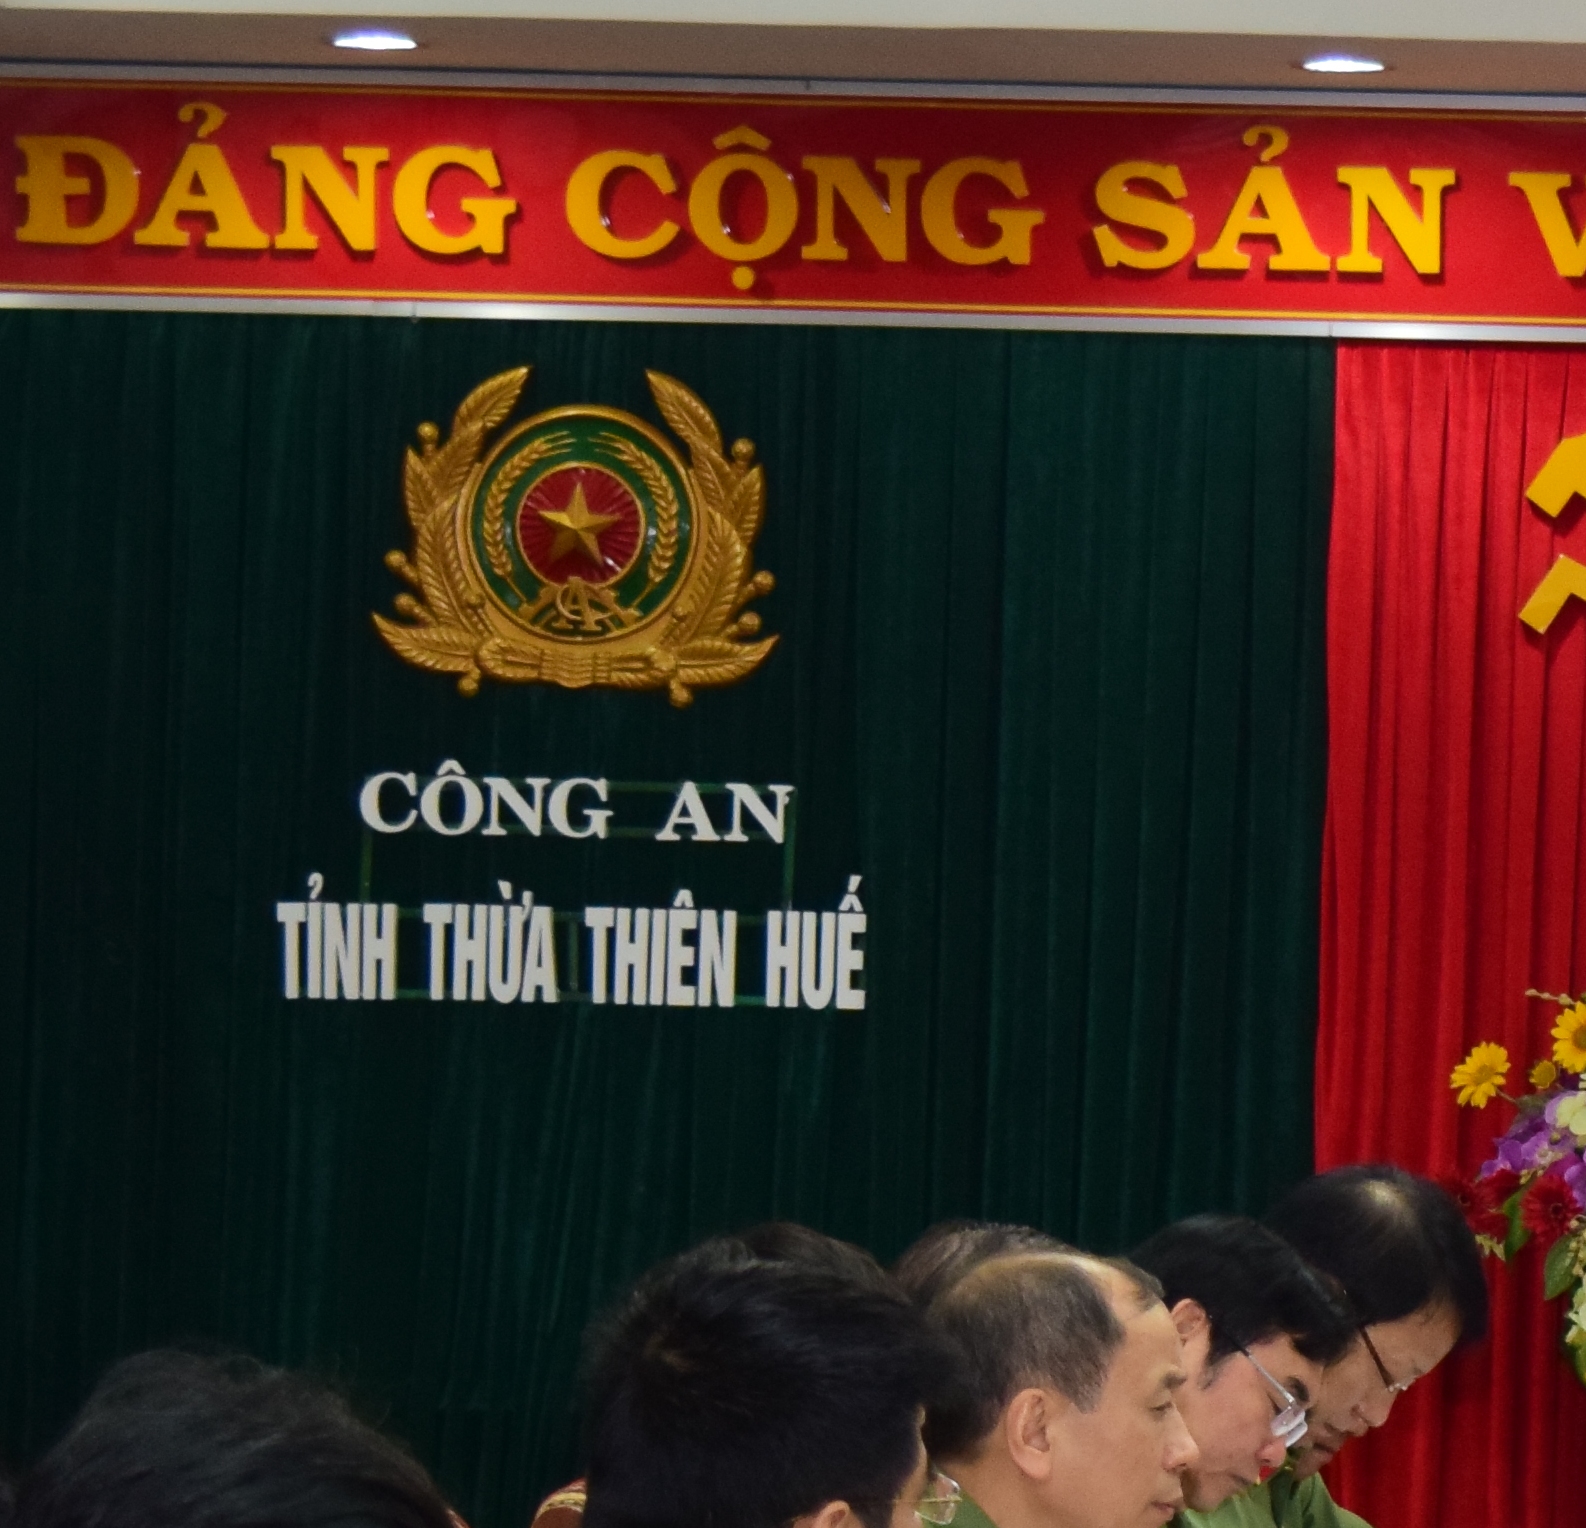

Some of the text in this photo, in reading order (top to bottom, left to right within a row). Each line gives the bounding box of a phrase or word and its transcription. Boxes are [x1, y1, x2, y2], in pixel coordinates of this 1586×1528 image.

[15, 101, 517, 256] ĐẢNG
[563, 124, 1044, 292] CỘNG
[1093, 125, 1456, 276] SẢN
[359, 759, 795, 844] CÔNG AN
[276, 872, 867, 1010] TỈNH THỪA THIÊN HUẾ
